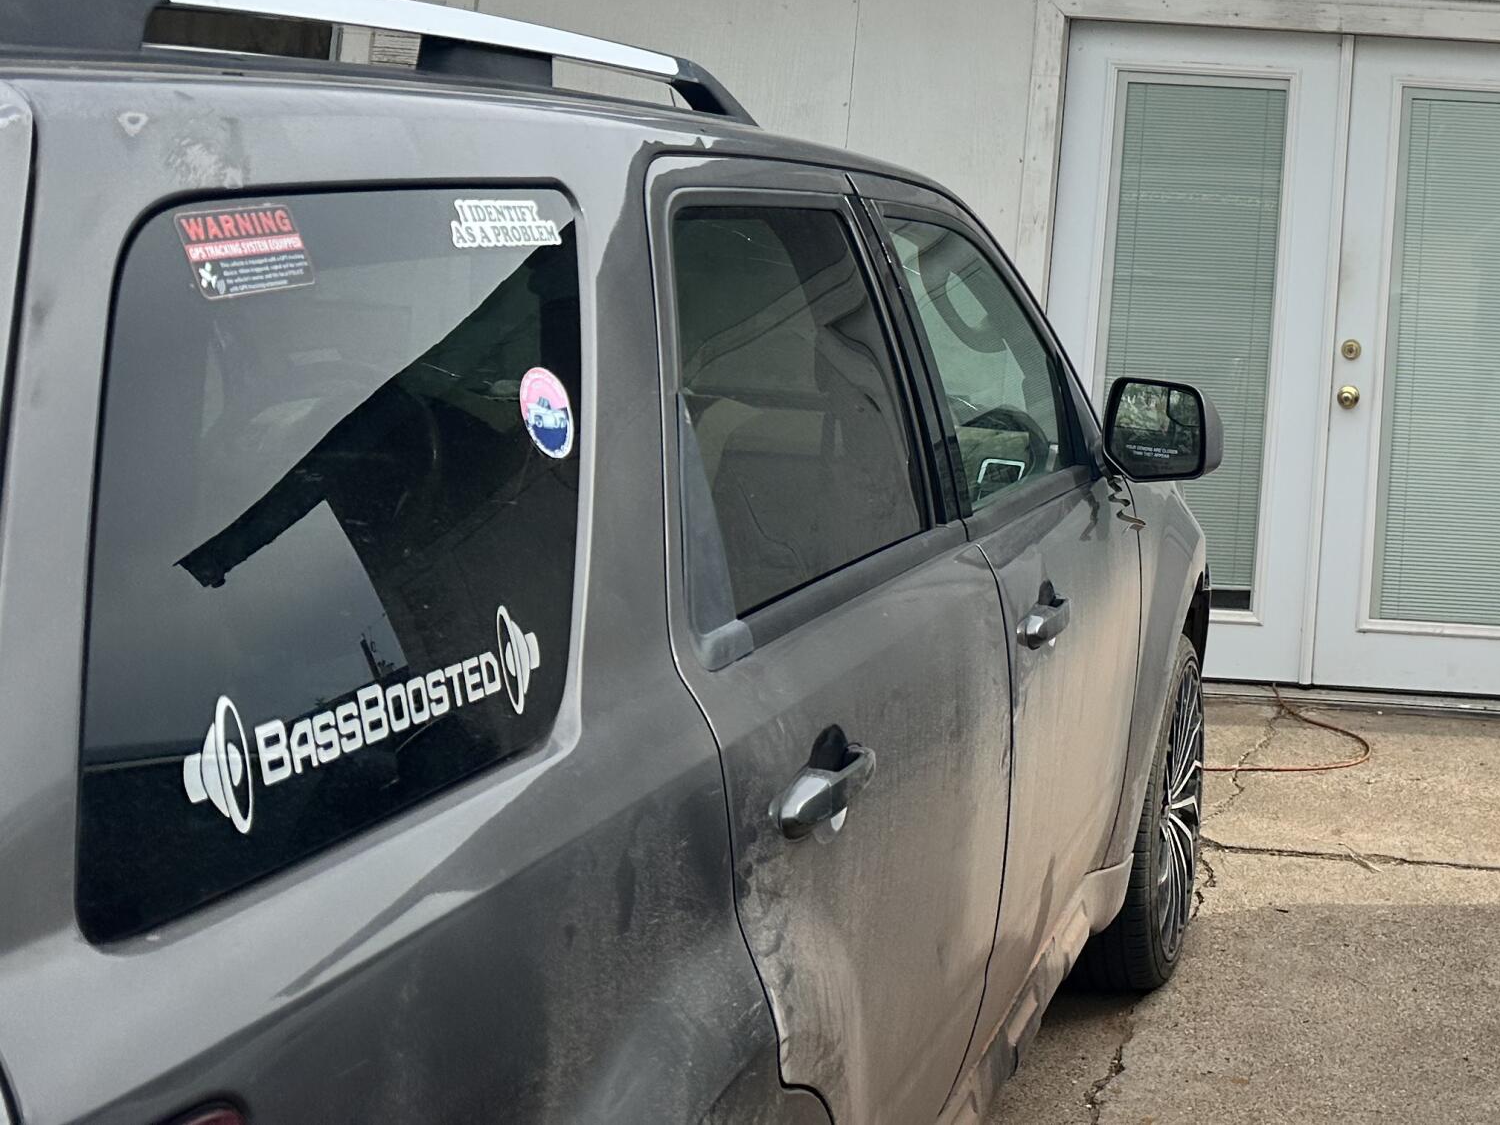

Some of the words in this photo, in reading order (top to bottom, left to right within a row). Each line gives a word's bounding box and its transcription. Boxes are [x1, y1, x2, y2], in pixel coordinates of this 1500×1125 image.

[458, 205, 467, 222] I
[468, 205, 537, 222] IDENTIFY
[180, 209, 293, 241] WARNING
[455, 226, 477, 244] AS
[480, 226, 491, 243] A
[492, 225, 558, 243] PROBLEM
